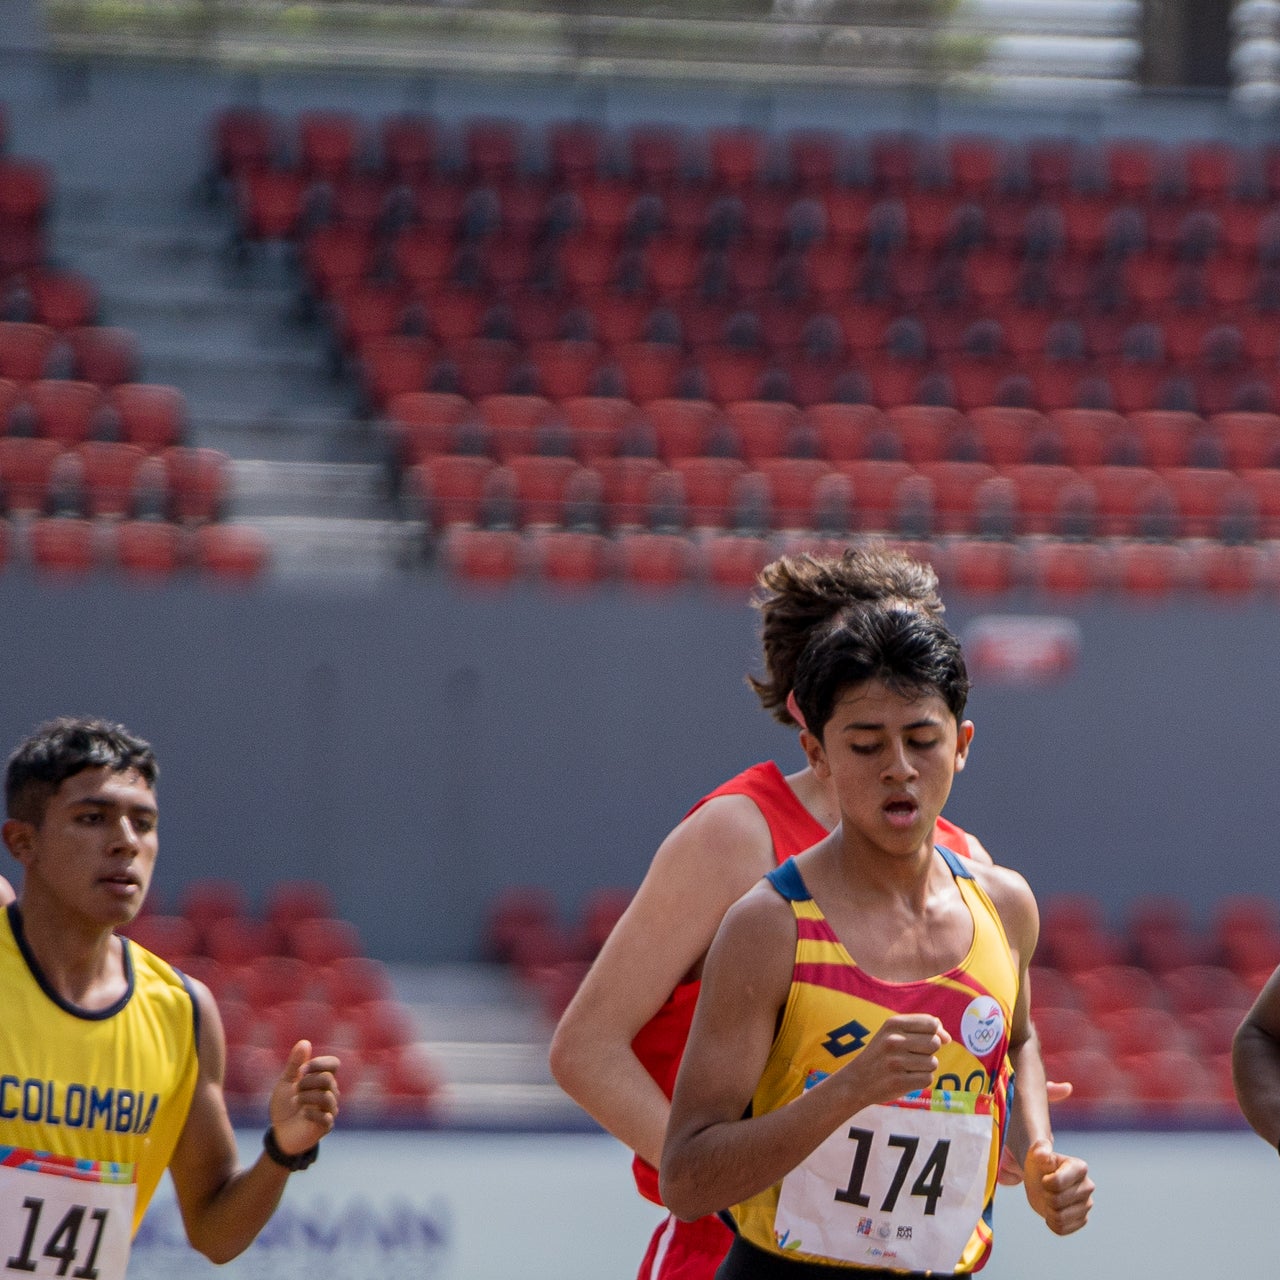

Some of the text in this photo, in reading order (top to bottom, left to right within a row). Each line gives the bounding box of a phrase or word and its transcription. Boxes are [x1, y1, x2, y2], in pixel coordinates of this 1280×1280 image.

[0, 1075, 159, 1134] COLOMBIA
[834, 1127, 951, 1216] 174
[6, 1197, 109, 1280] 141
